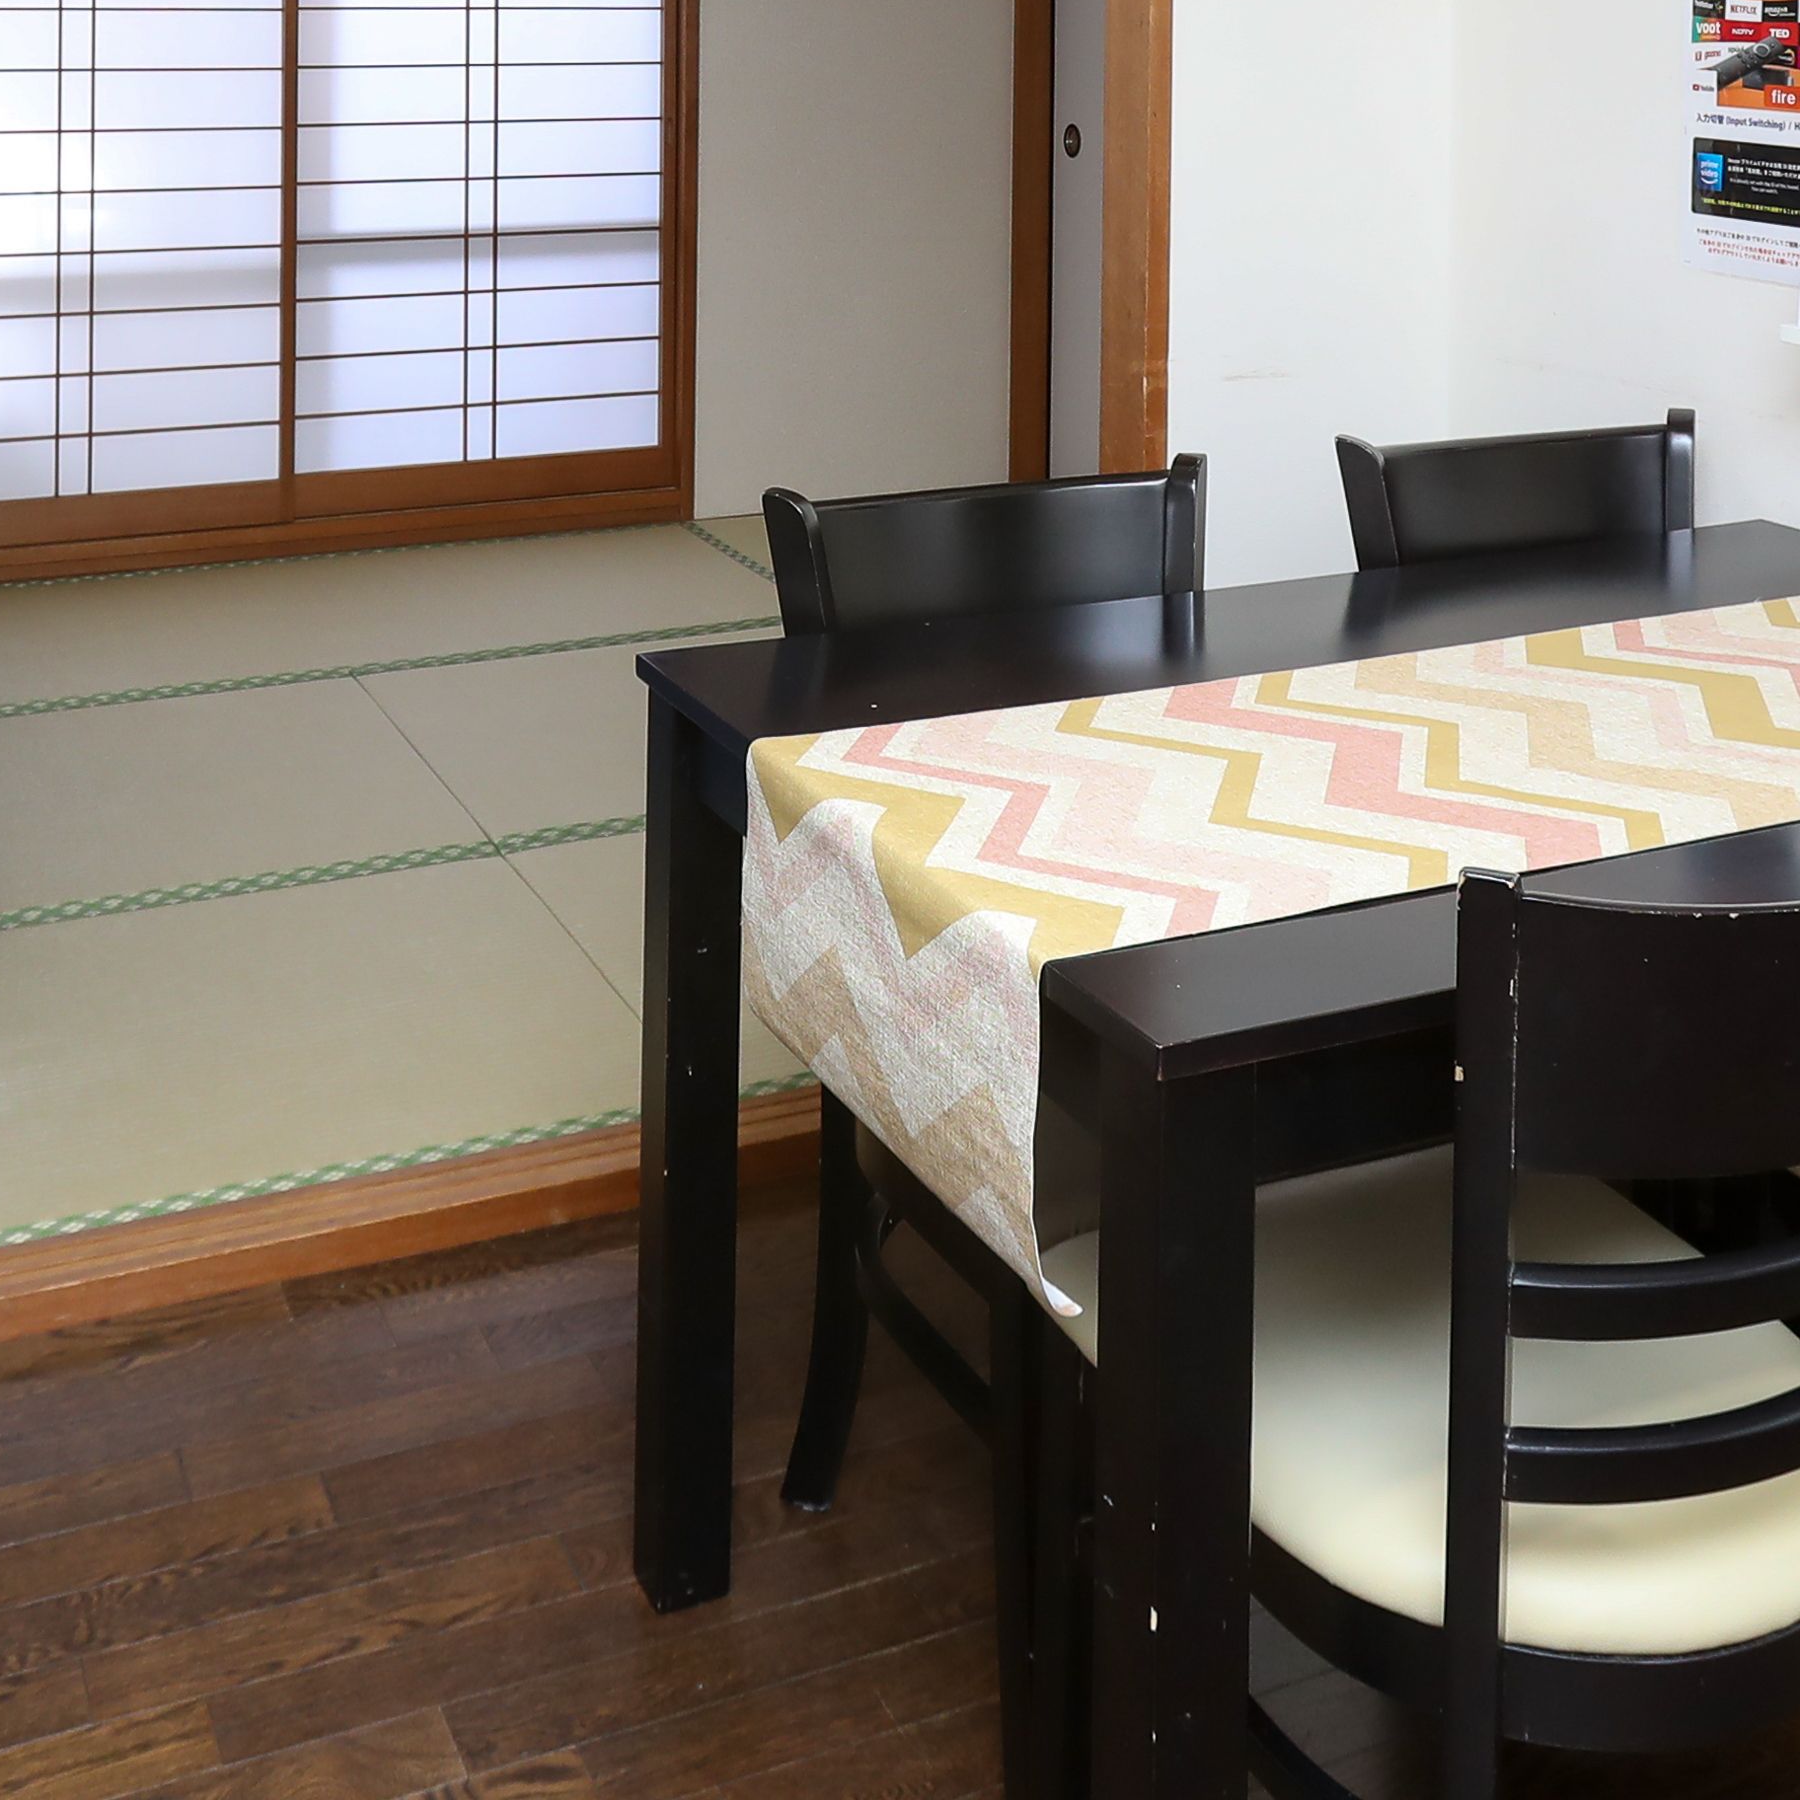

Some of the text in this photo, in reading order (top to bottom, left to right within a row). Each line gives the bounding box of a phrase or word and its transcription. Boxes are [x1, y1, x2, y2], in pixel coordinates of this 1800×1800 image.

[1730, 4, 1757, 15] NETFLIX
[1696, 21, 1721, 35] voot
[1731, 28, 1755, 36] NDTV
[1769, 28, 1790, 39] TED
[1771, 89, 1796, 105] fire
[1726, 115, 1748, 128] (Input
[1748, 117, 1787, 132] Switching)
[1700, 161, 1720, 171] prime
[1700, 169, 1720, 179] video
